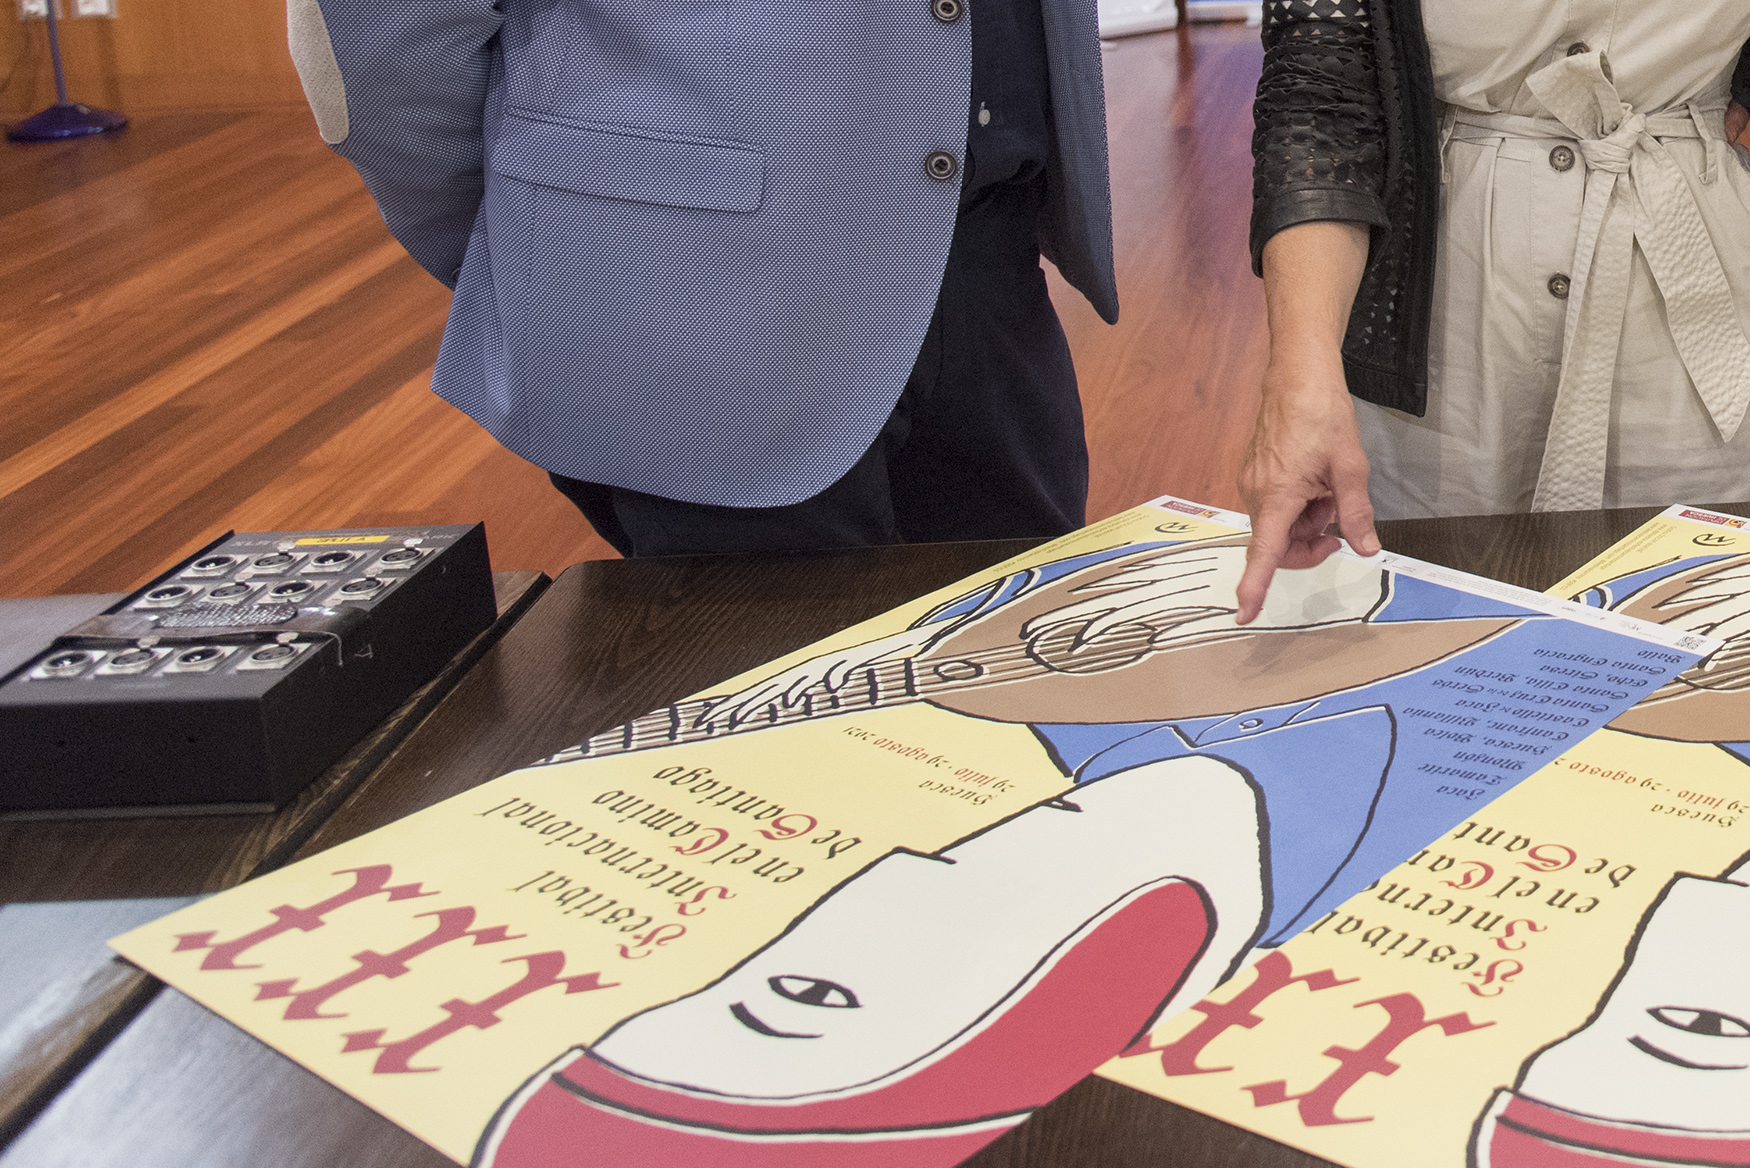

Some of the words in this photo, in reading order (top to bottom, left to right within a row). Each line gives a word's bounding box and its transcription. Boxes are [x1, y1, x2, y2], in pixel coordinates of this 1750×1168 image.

[1532, 648, 1608, 667] Engracia
[1638, 649, 1686, 664] Bailo
[1540, 664, 1600, 680] Siresa
[1611, 660, 1666, 675] Santa
[1512, 690, 1552, 706] Cruz
[1572, 686, 1629, 700] Santa
[1455, 699, 1498, 715] Jaca
[1552, 698, 1610, 713] Santa
[1511, 710, 1590, 728] Castiello
[843, 726, 876, 740] 2021
[1423, 727, 1478, 745] Bolea
[872, 738, 929, 760] agosto
[1483, 738, 1552, 756] Huesca,
[926, 755, 950, 768] 29
[1453, 750, 1524, 772] Monzón
[954, 768, 996, 788] julio
[1418, 763, 1508, 786] Tamarite
[1569, 761, 1638, 784] agosto
[918, 780, 998, 806] Huesca
[992, 779, 1016, 793] 29
[1436, 785, 1486, 801] Jaca
[1639, 778, 1663, 792] 29
[653, 766, 818, 840] Santiago
[1677, 790, 1726, 810] julio
[1727, 800, 1750, 814] 29
[592, 790, 730, 856] Camino
[1650, 803, 1740, 828] Huesca
[811, 829, 862, 860] de
[474, 797, 737, 916] Internacional
[1584, 857, 1638, 888] de
[507, 870, 687, 959] Festival
[172, 864, 621, 1074] XXX
